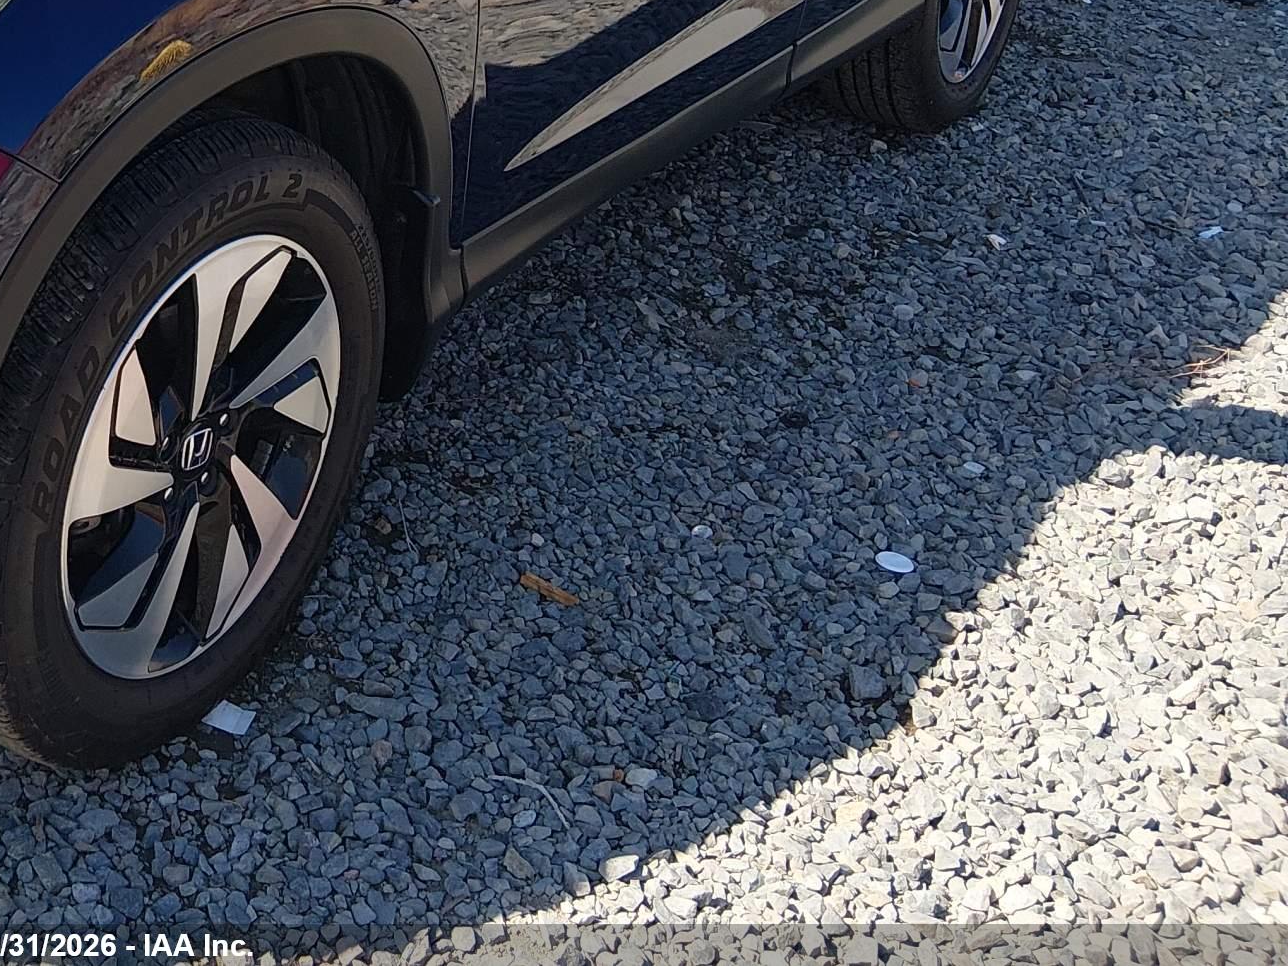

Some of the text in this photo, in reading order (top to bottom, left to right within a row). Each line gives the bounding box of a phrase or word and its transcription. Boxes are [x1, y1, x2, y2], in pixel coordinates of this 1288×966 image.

[31, 173, 304, 523] ROAD CONTROL 2
